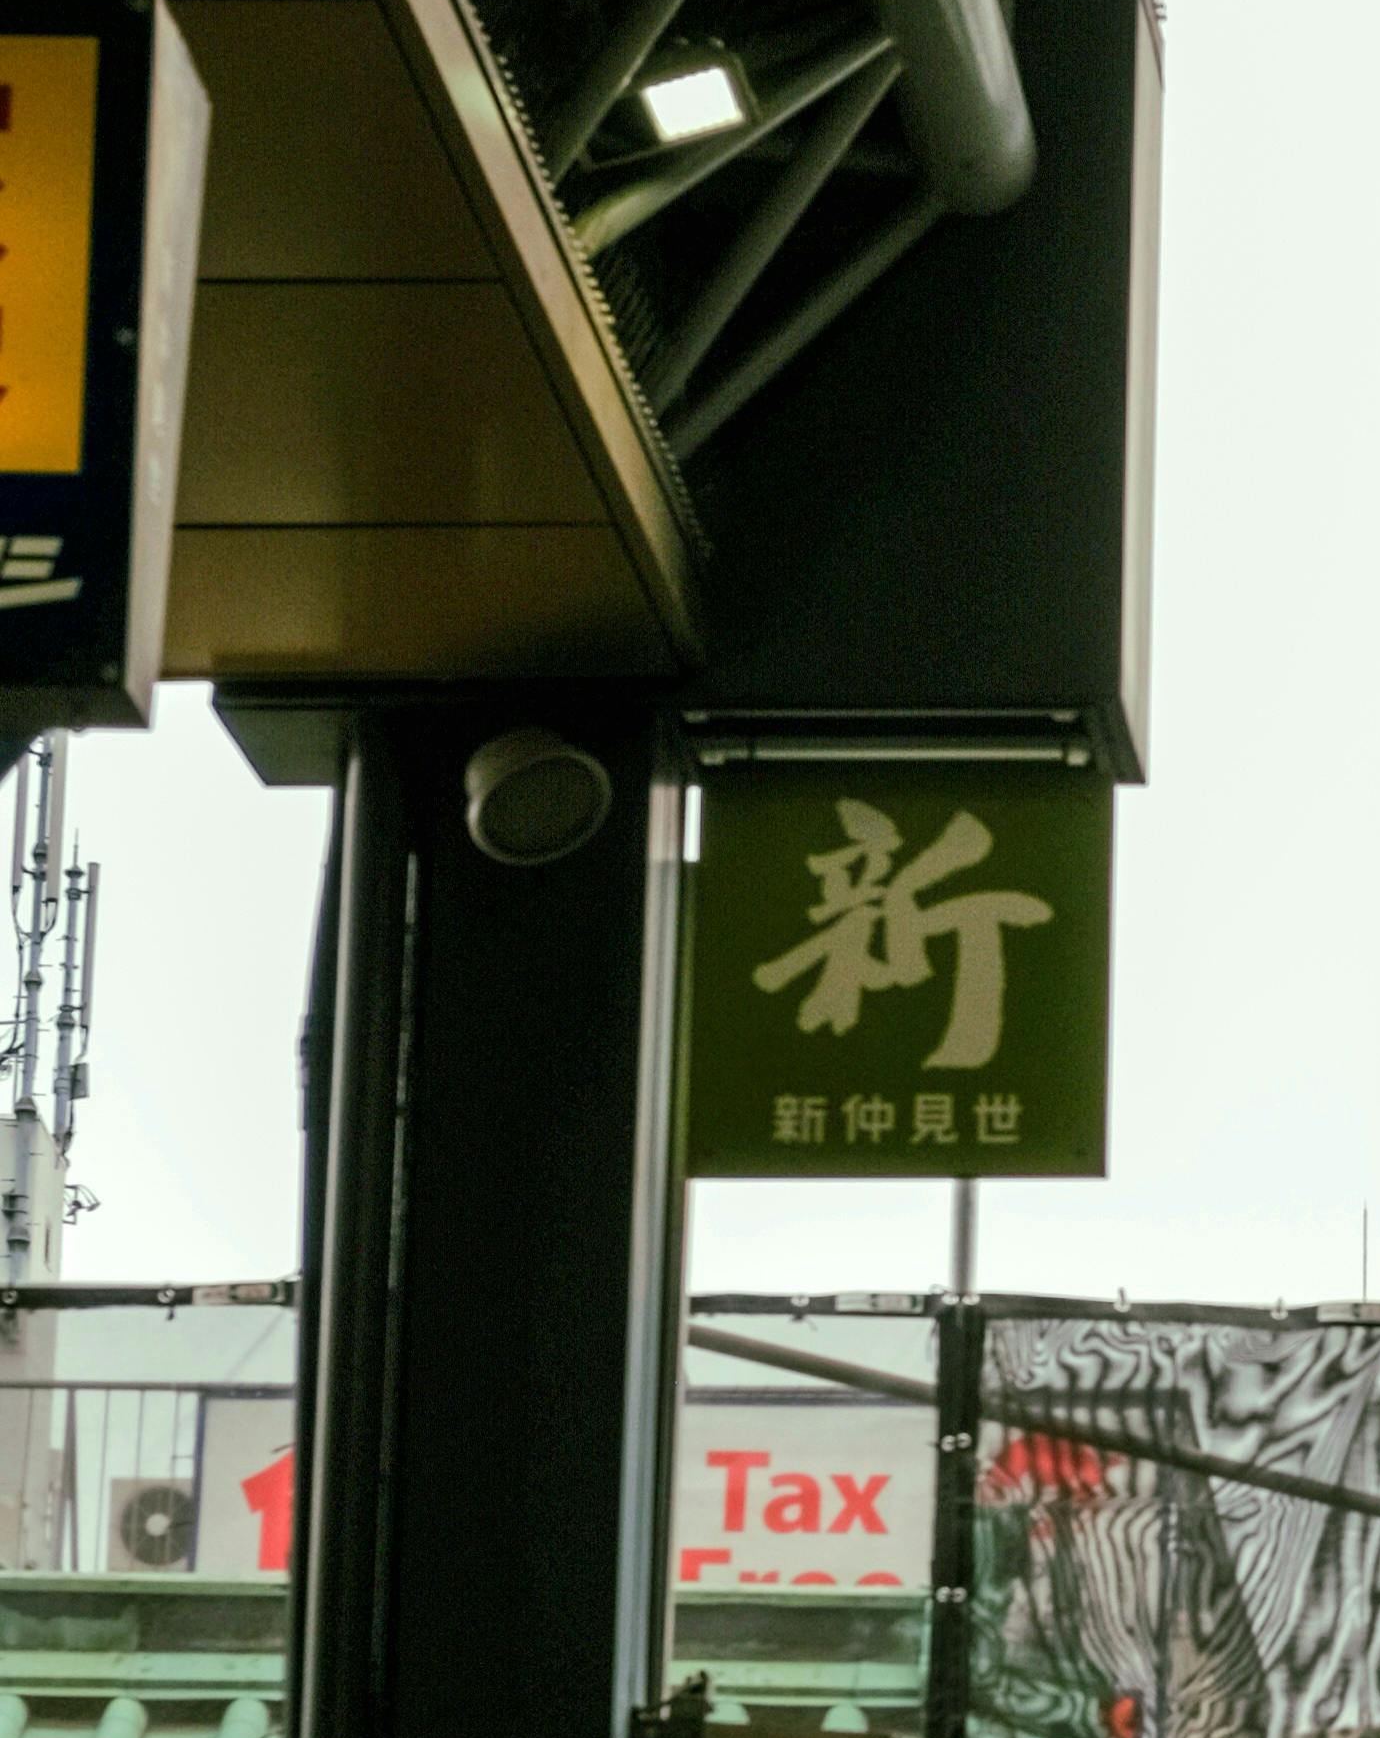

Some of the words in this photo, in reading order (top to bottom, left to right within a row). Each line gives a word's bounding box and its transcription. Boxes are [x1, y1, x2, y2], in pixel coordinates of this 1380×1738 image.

[752, 798, 1052, 1070] 新
[772, 1095, 1023, 1144] 新仲見世
[707, 1451, 891, 1534] Tax
